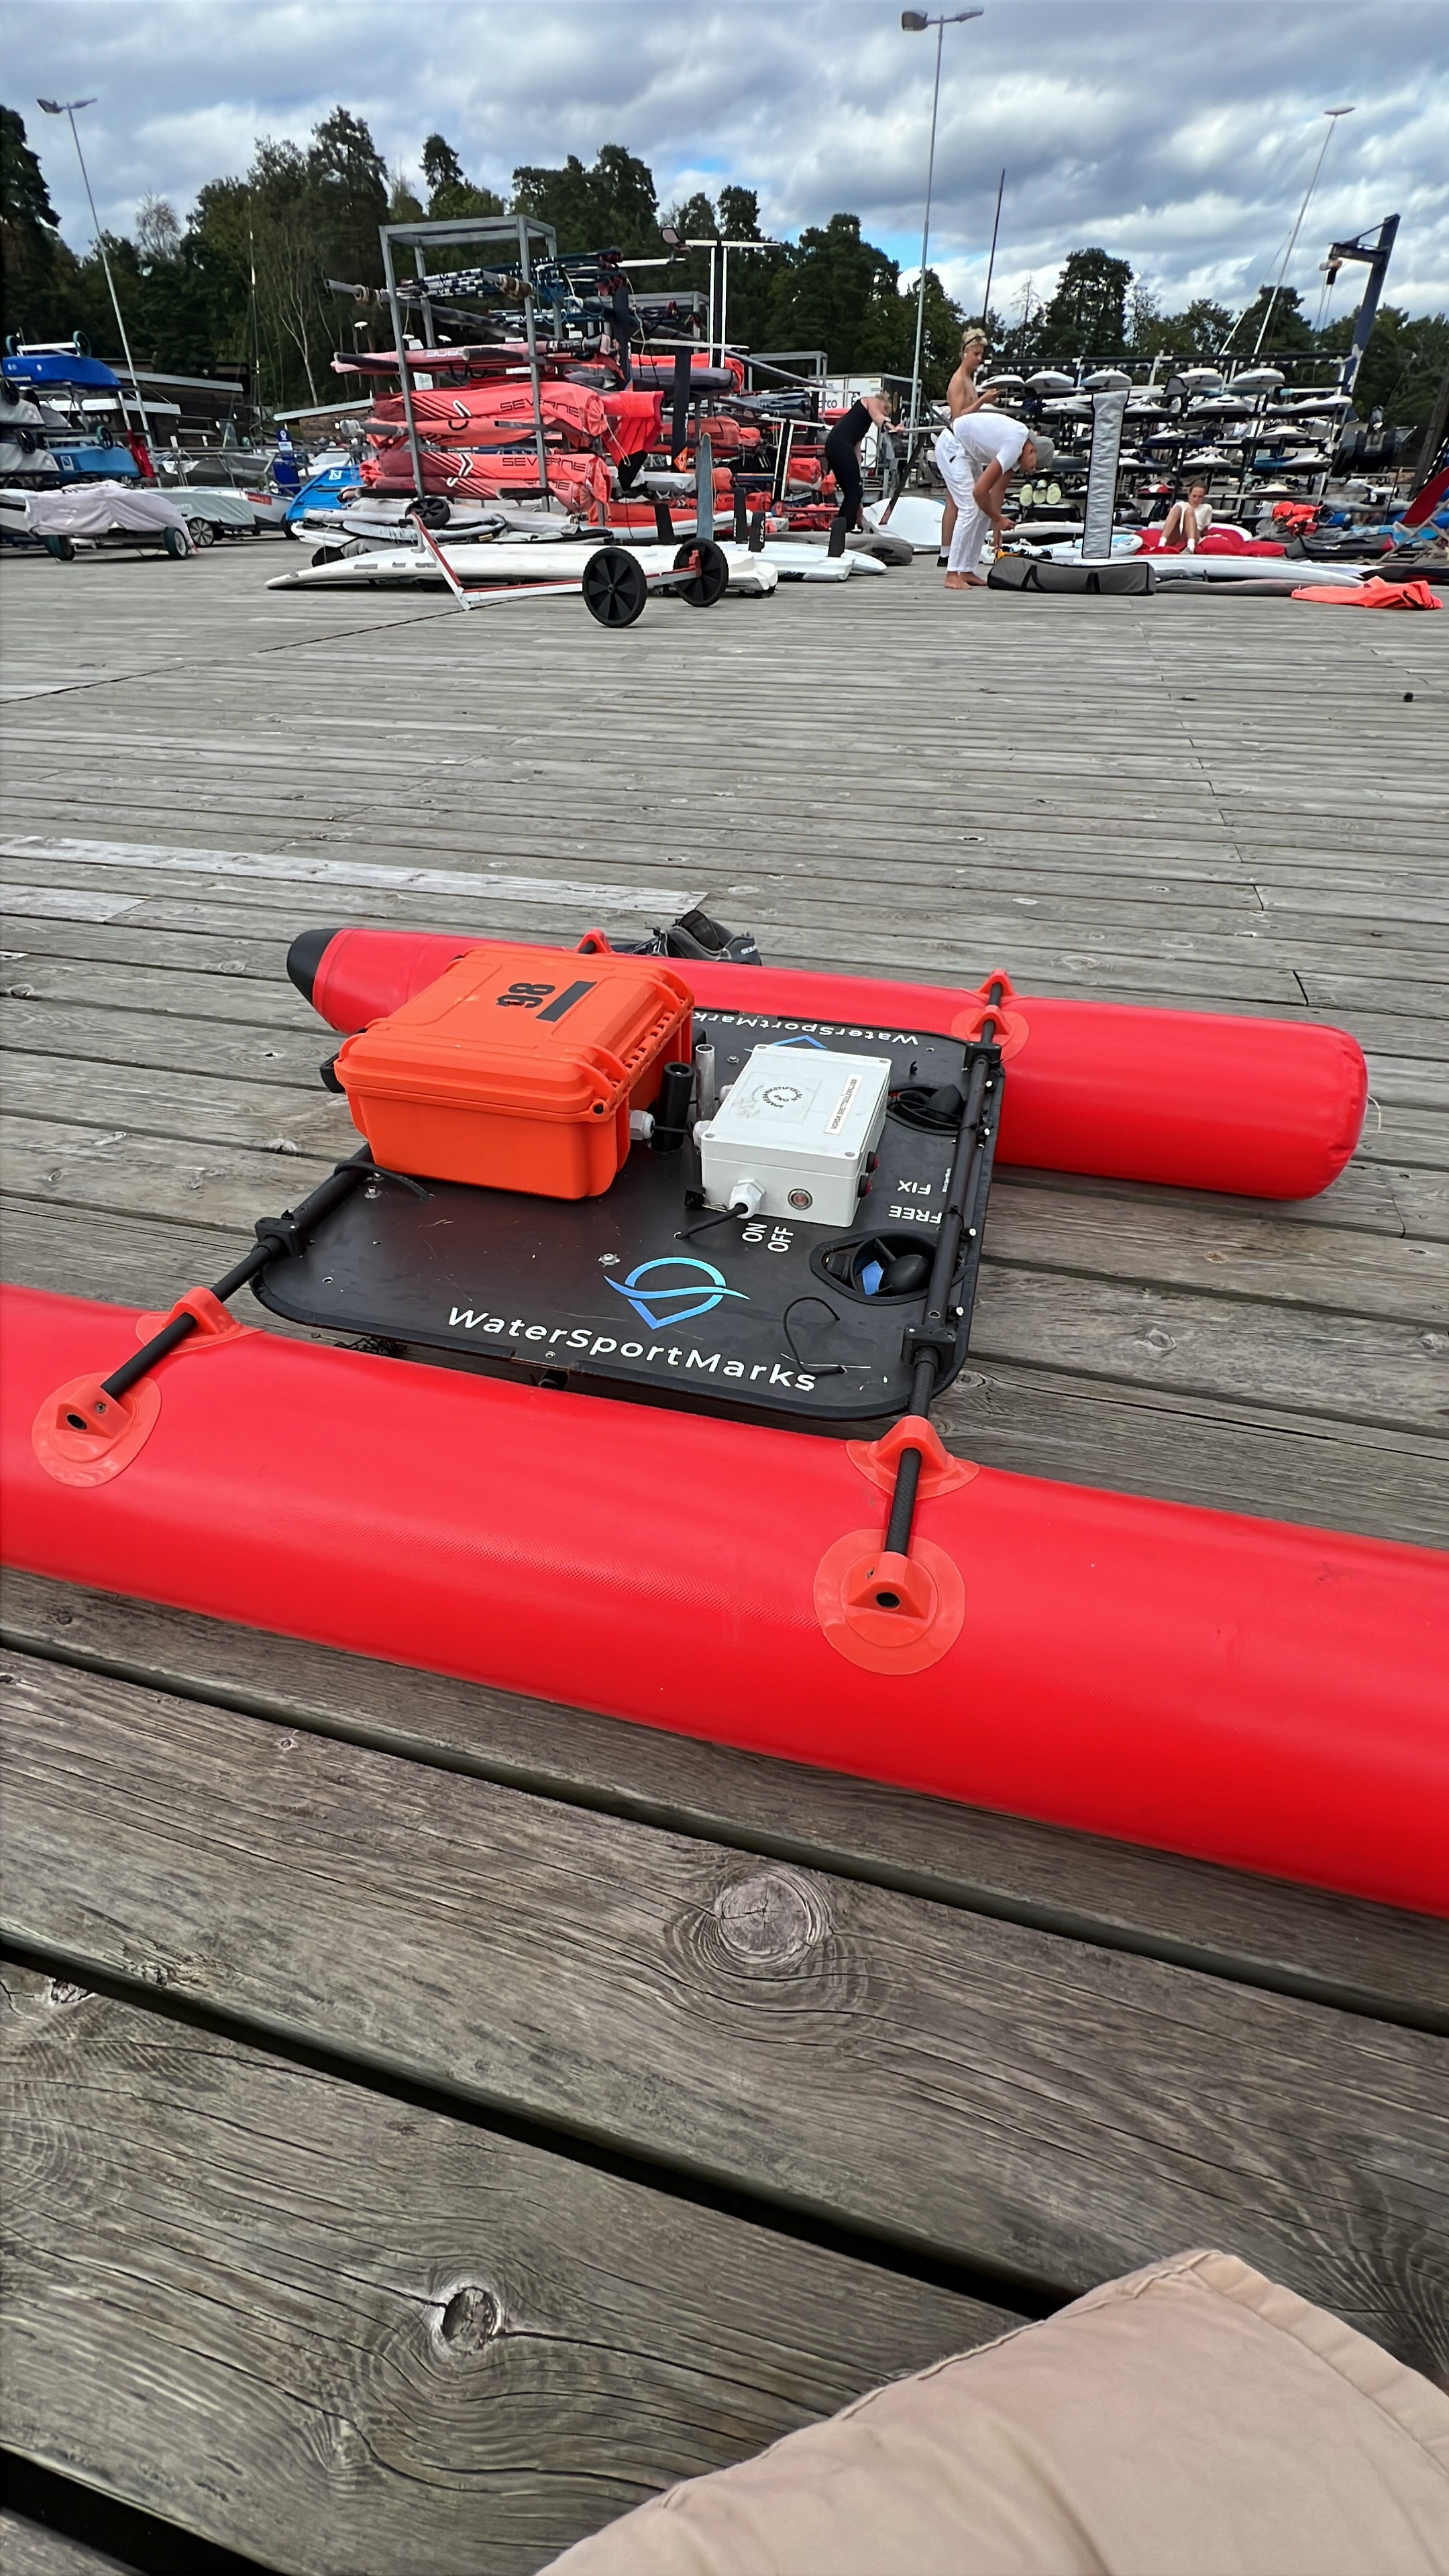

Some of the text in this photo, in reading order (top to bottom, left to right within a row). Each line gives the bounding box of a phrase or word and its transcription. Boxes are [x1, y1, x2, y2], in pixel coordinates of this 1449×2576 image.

[500, 398, 580, 418] SEVRNE
[897, 1180, 931, 1195] FIX
[888, 1205, 942, 1224] FREE
[742, 1222, 767, 1242] ON
[767, 1226, 794, 1252] OFF
[448, 1307, 816, 1391] WaterSportMarks
